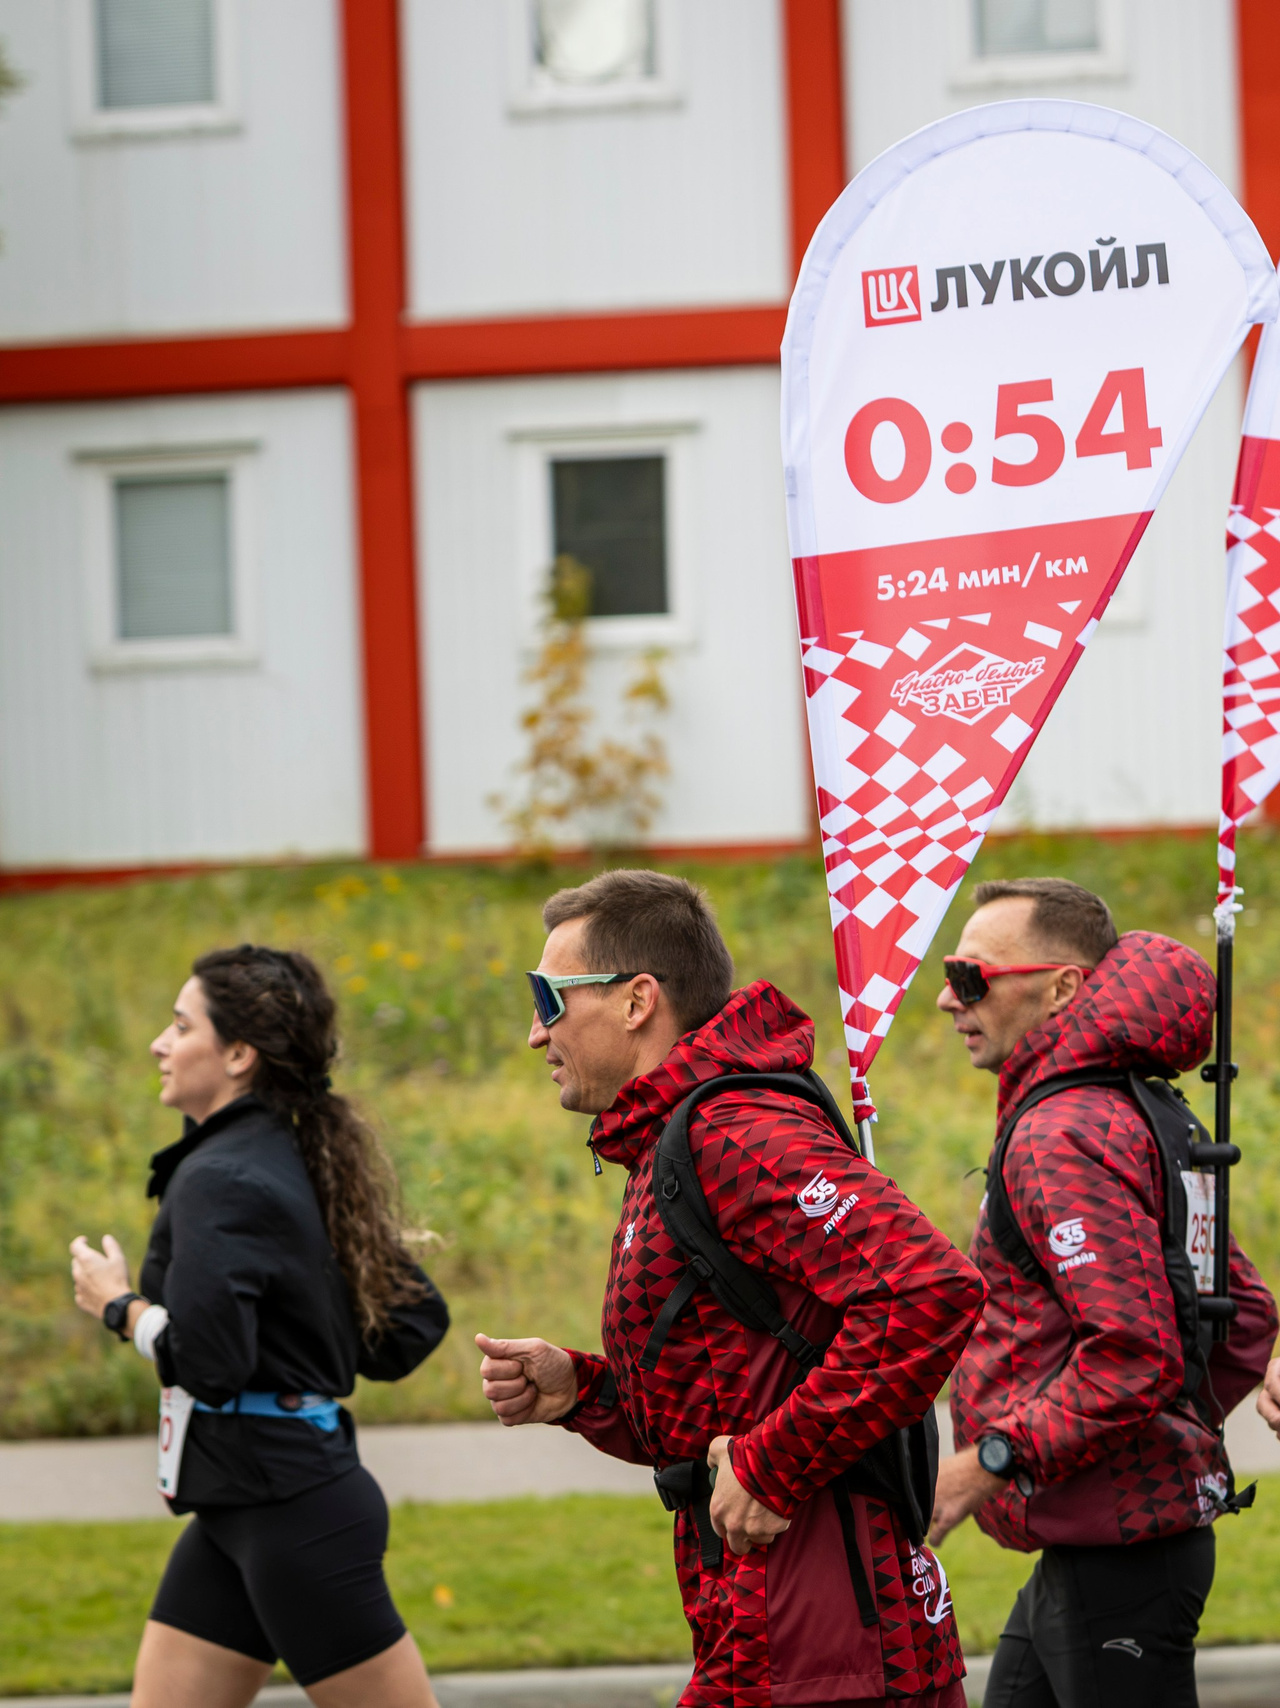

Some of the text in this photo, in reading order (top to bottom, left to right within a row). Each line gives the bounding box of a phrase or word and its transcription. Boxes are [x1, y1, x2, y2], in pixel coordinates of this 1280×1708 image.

[931, 237, 1169, 312] ЛУКОЙЛ
[844, 366, 1163, 504] 0:54
[877, 567, 949, 601] 5:24
[922, 683, 1016, 715] ЗАБЕГ
[805, 1177, 837, 1205] 35
[1059, 1223, 1087, 1246] 35
